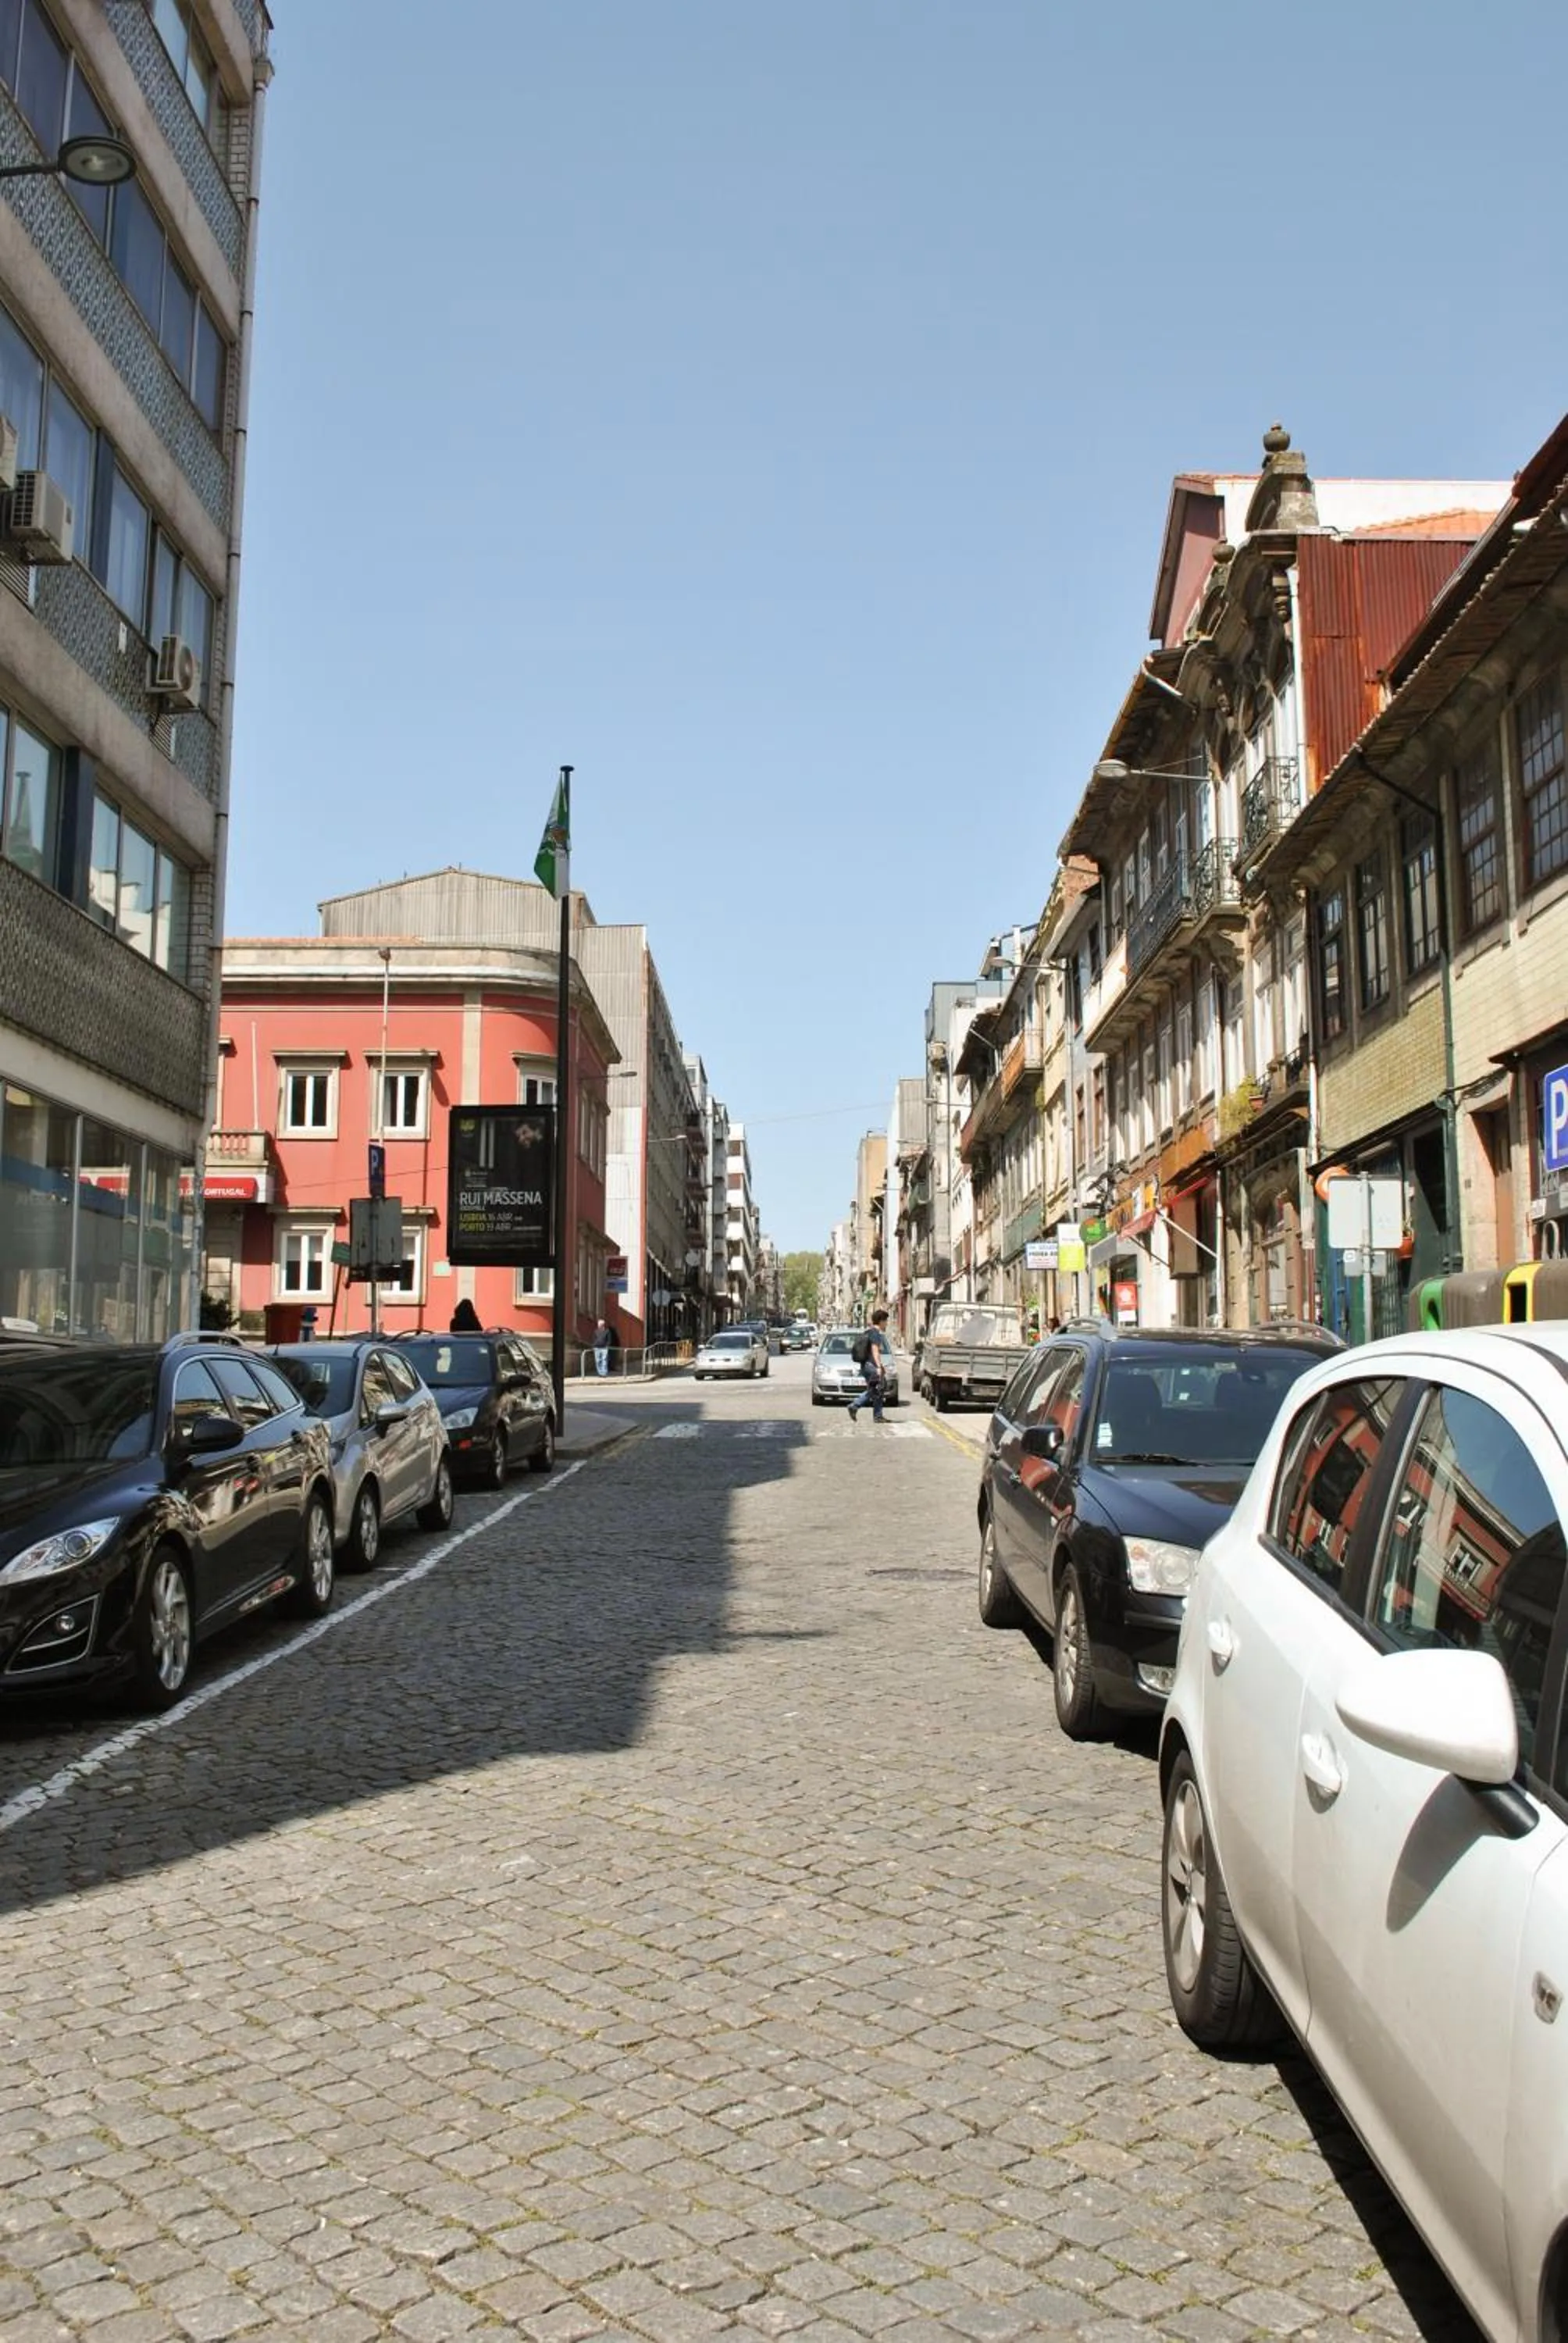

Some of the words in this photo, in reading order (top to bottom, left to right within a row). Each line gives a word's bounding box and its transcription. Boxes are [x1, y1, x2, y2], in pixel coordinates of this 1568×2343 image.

[1551, 1079, 1568, 1160] P
[371, 1149, 379, 1175] P
[460, 1192, 481, 1205] RUI
[483, 1191, 543, 1205] MASSENA
